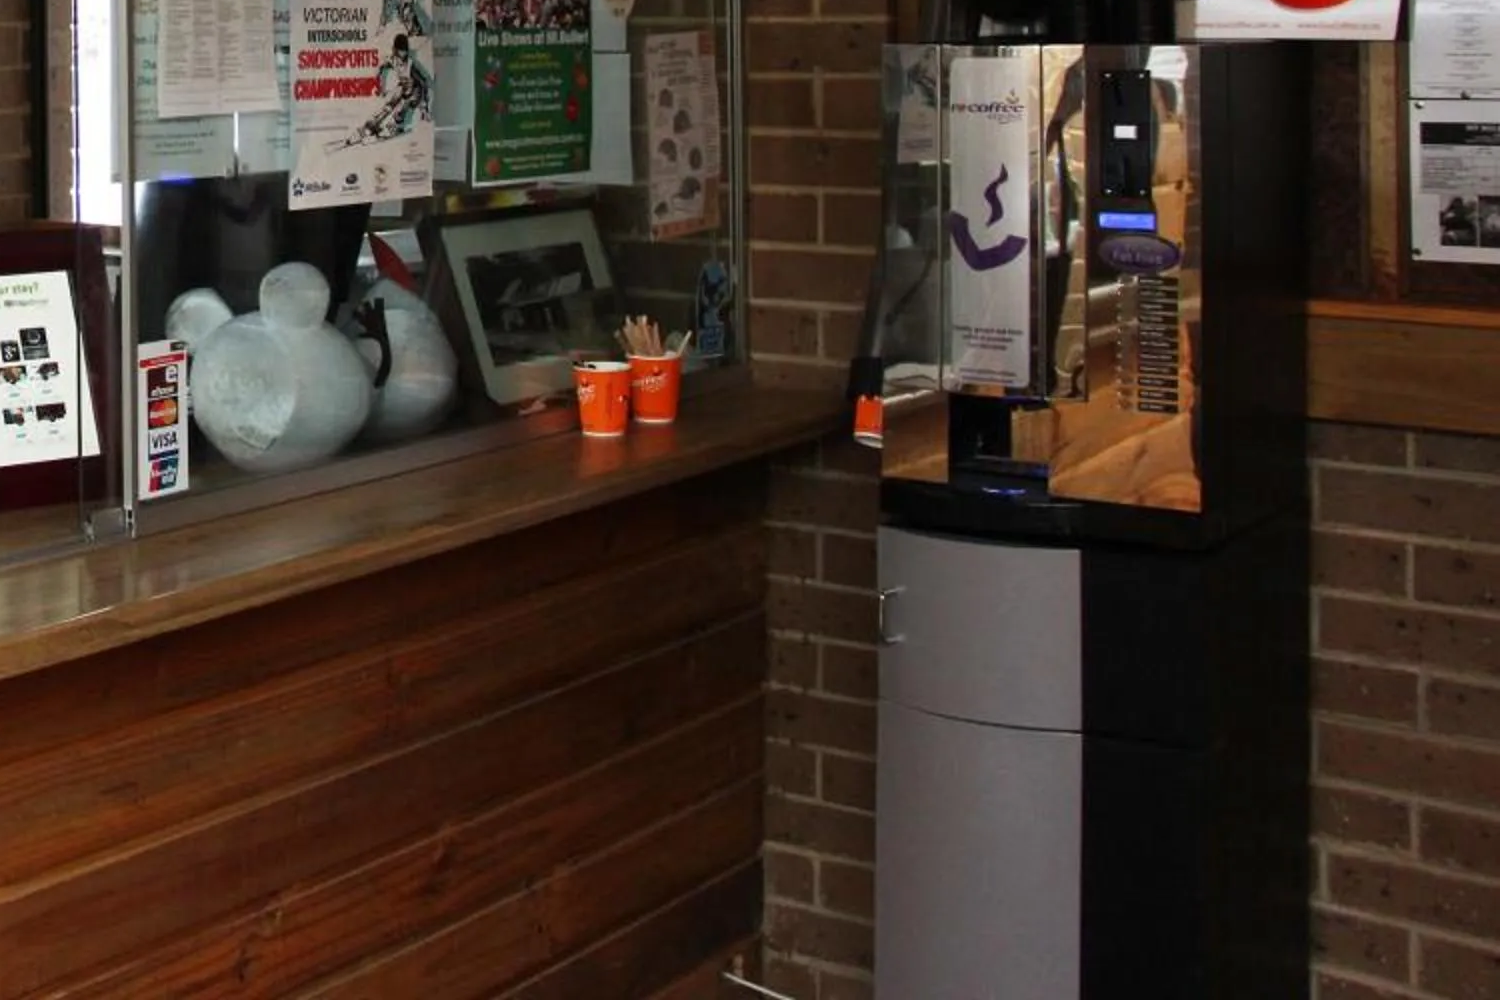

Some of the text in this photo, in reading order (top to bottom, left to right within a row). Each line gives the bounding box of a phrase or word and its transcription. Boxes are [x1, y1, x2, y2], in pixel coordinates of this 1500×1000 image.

[304, 7, 368, 23] VICTORIAN
[298, 48, 380, 69] SNOWSPORTS
[294, 75, 382, 100] CHAMPIONSHIPS
[152, 431, 178, 449] VISA
